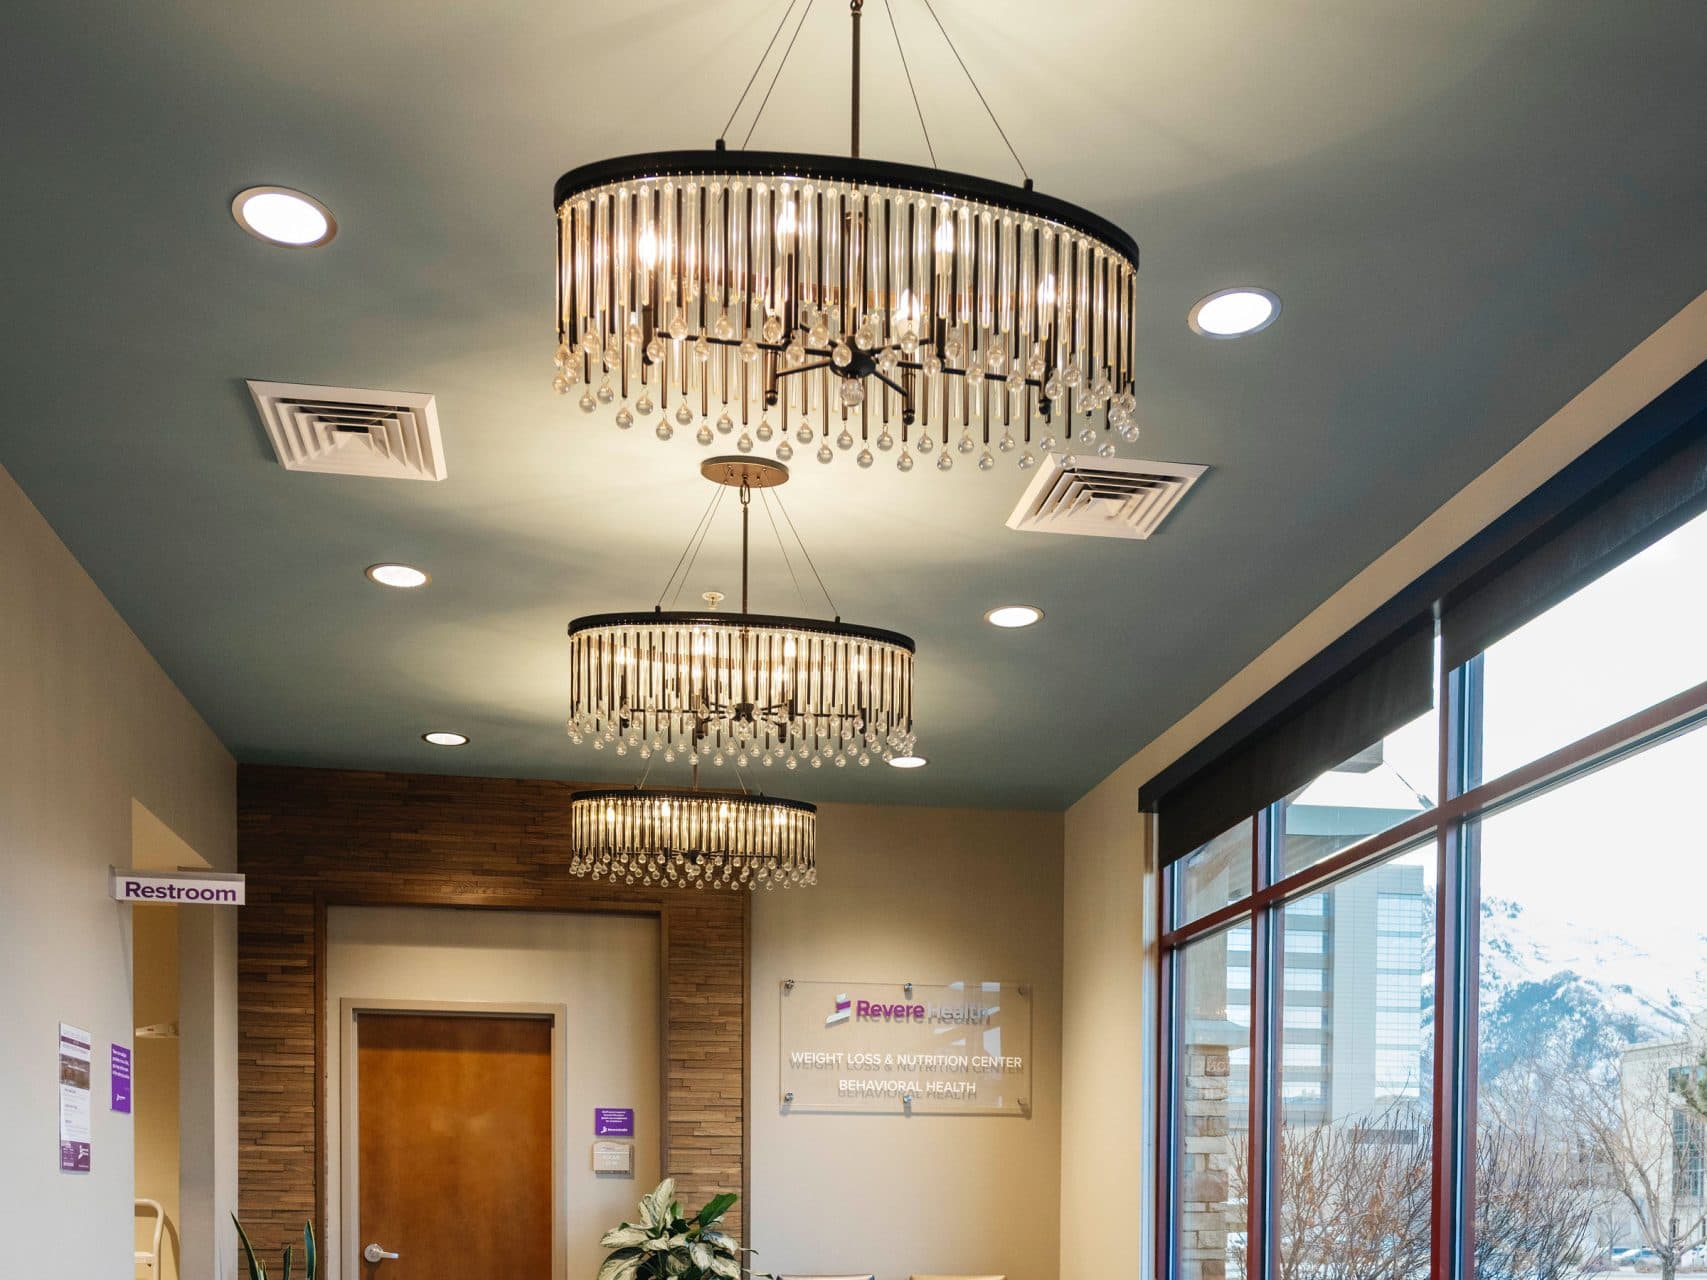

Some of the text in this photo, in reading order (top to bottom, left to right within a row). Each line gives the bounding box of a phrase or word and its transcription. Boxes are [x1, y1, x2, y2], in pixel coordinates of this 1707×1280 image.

[125, 881, 236, 901] Restroom
[856, 1000, 925, 1018] Revere
[791, 1052, 1022, 1068] WEIGHT LOSS & NUTRITION CENTER
[839, 1079, 976, 1093] BEHAVIORAL HEALTH
